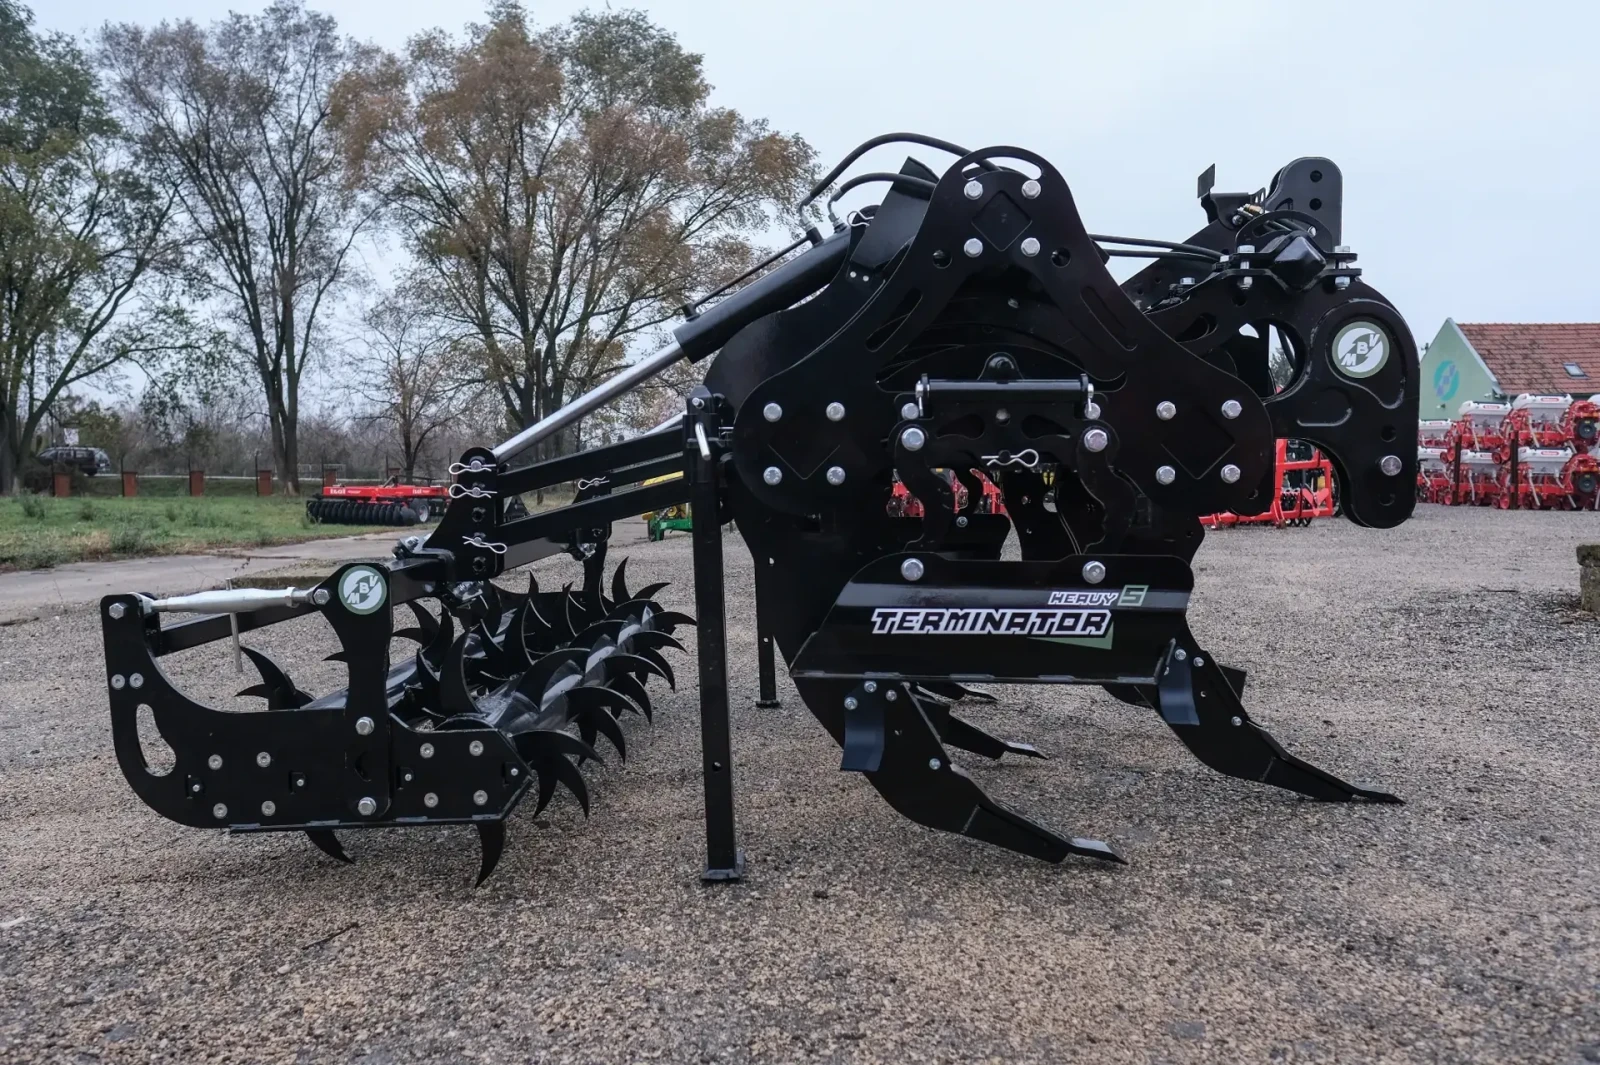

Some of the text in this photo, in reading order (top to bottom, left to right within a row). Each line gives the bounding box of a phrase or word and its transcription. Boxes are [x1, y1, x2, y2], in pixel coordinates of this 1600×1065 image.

[1340, 333, 1380, 366] MBV
[346, 575, 379, 604] MBV
[871, 608, 1112, 635] TERMINATOR
